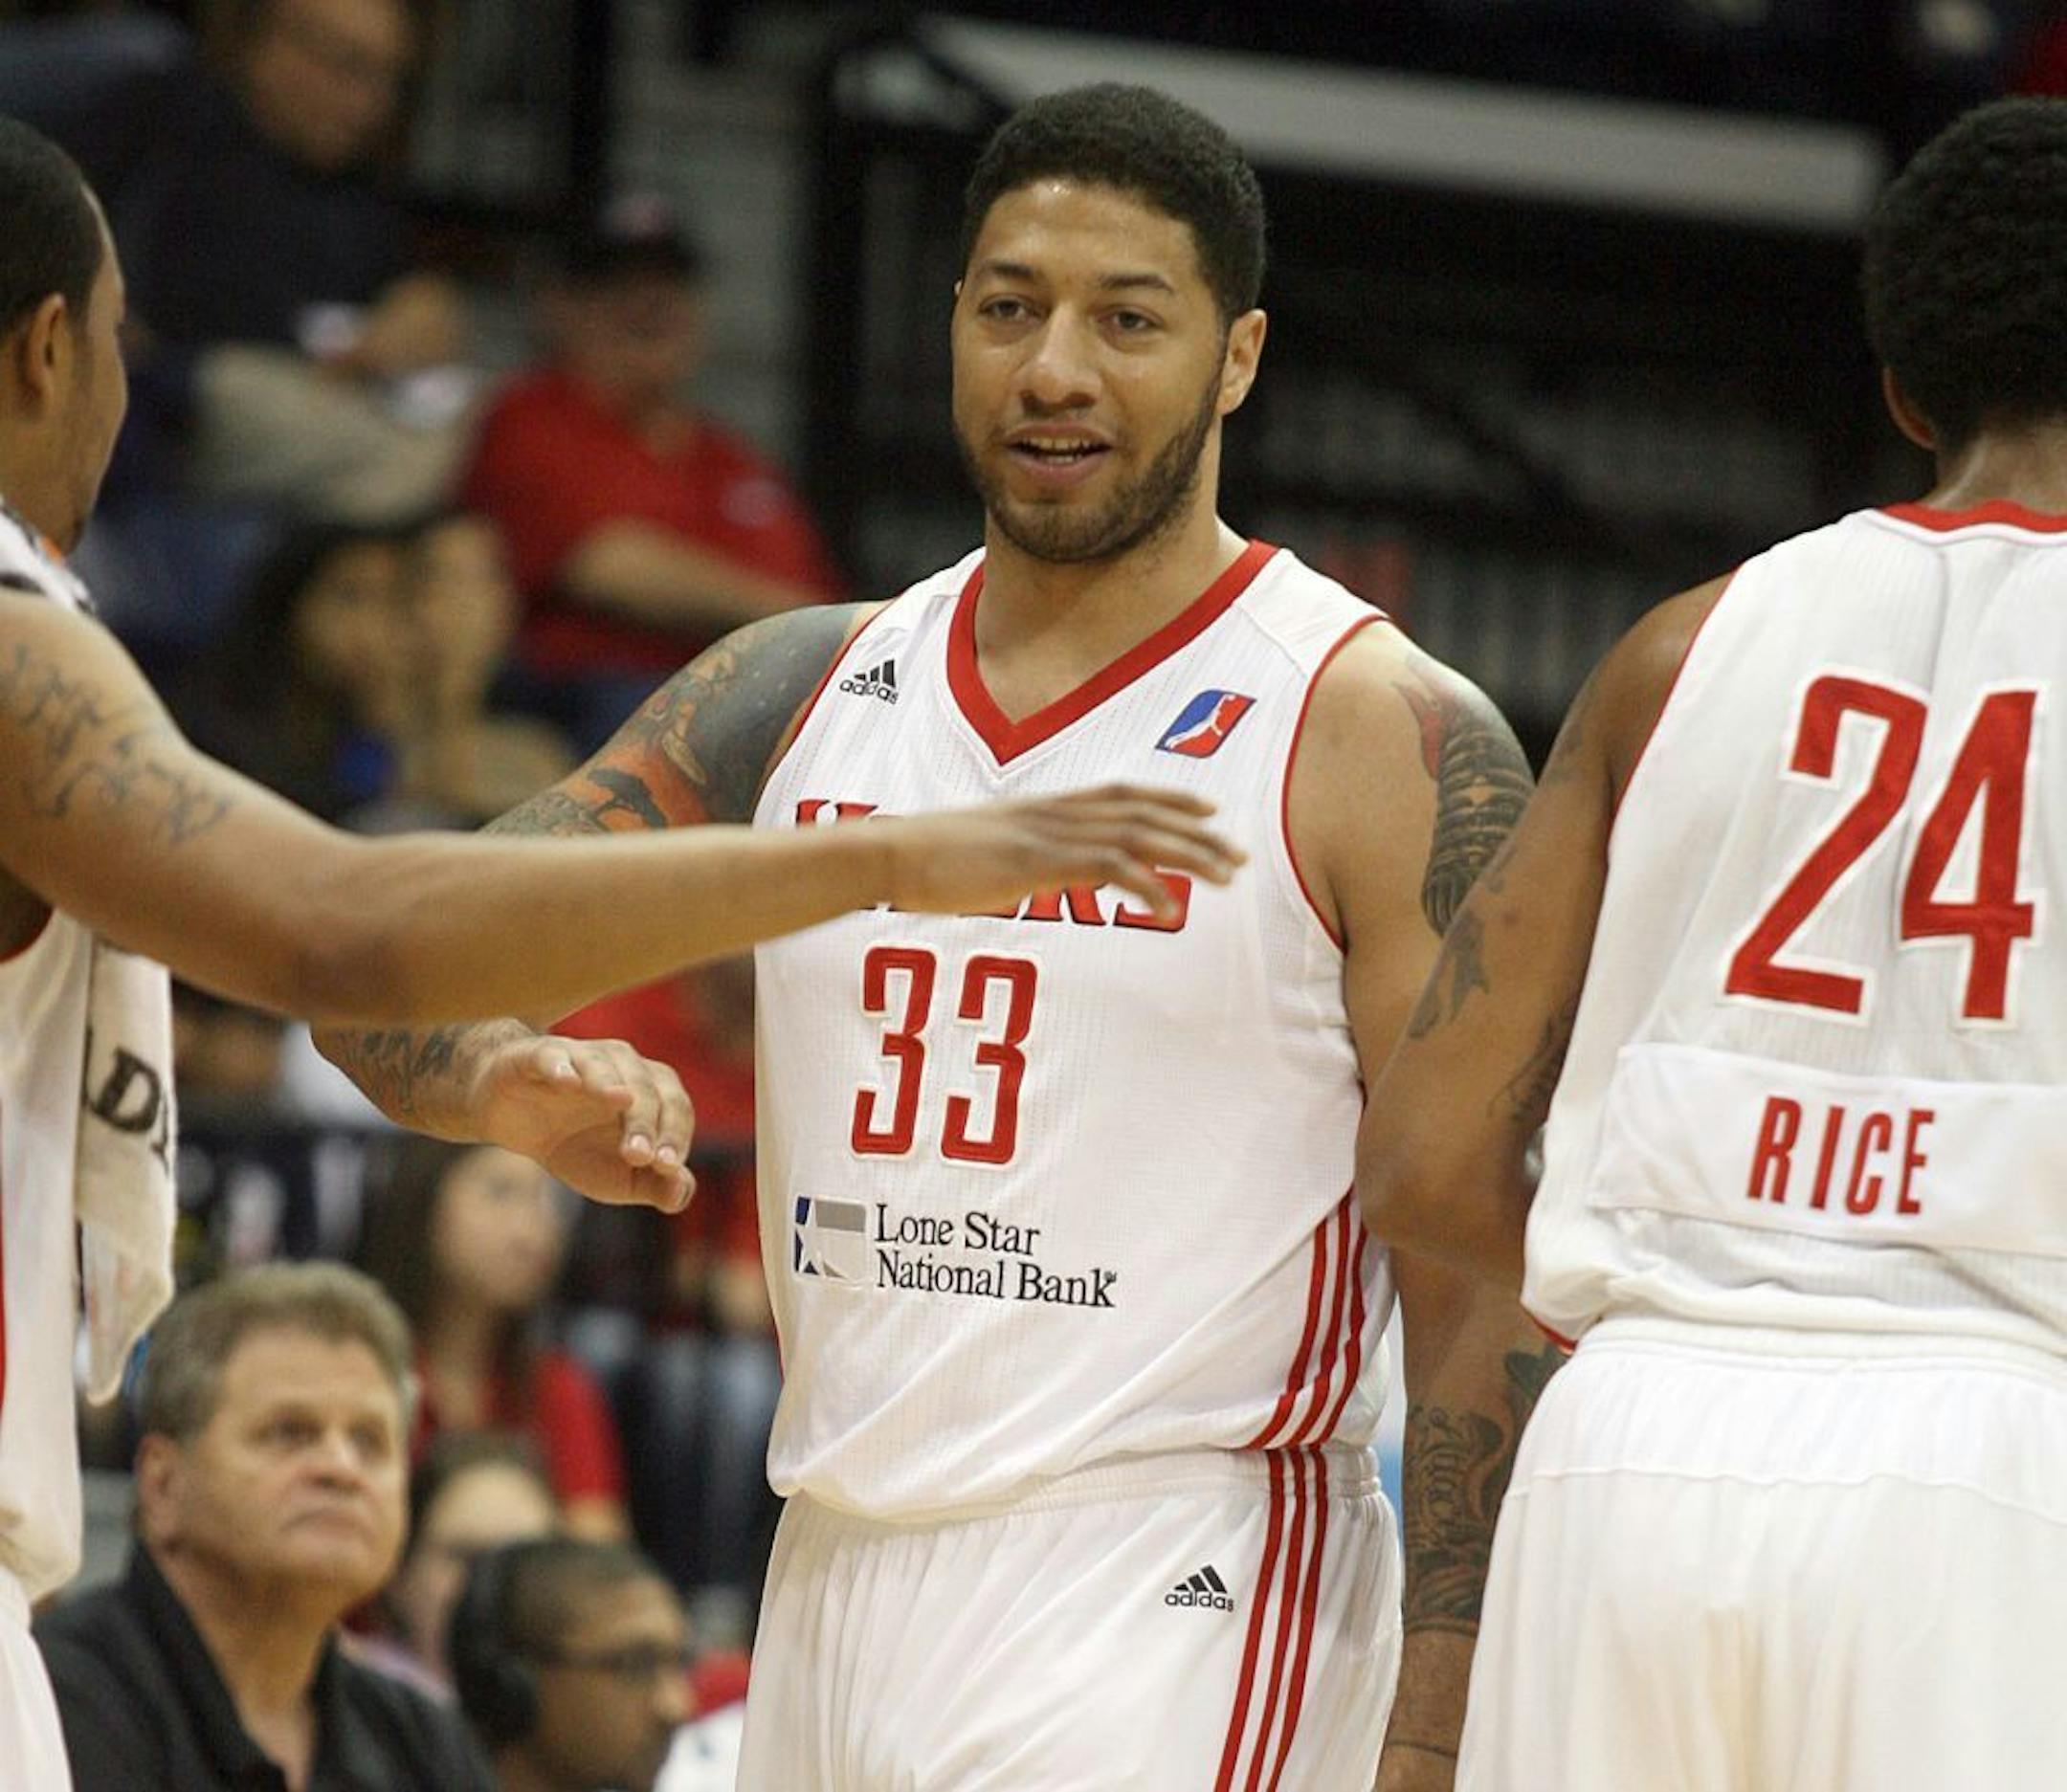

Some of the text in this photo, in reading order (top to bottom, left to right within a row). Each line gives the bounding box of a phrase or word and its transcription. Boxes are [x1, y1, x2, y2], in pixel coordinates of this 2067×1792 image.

[1721, 672, 2040, 1024] 24
[849, 944, 1039, 1166] 33
[1745, 1094, 1936, 1218] RICE
[875, 1203, 1041, 1256] Lone Star
[876, 1248, 1006, 1300] National
[1165, 1590, 1234, 1613] adidas
